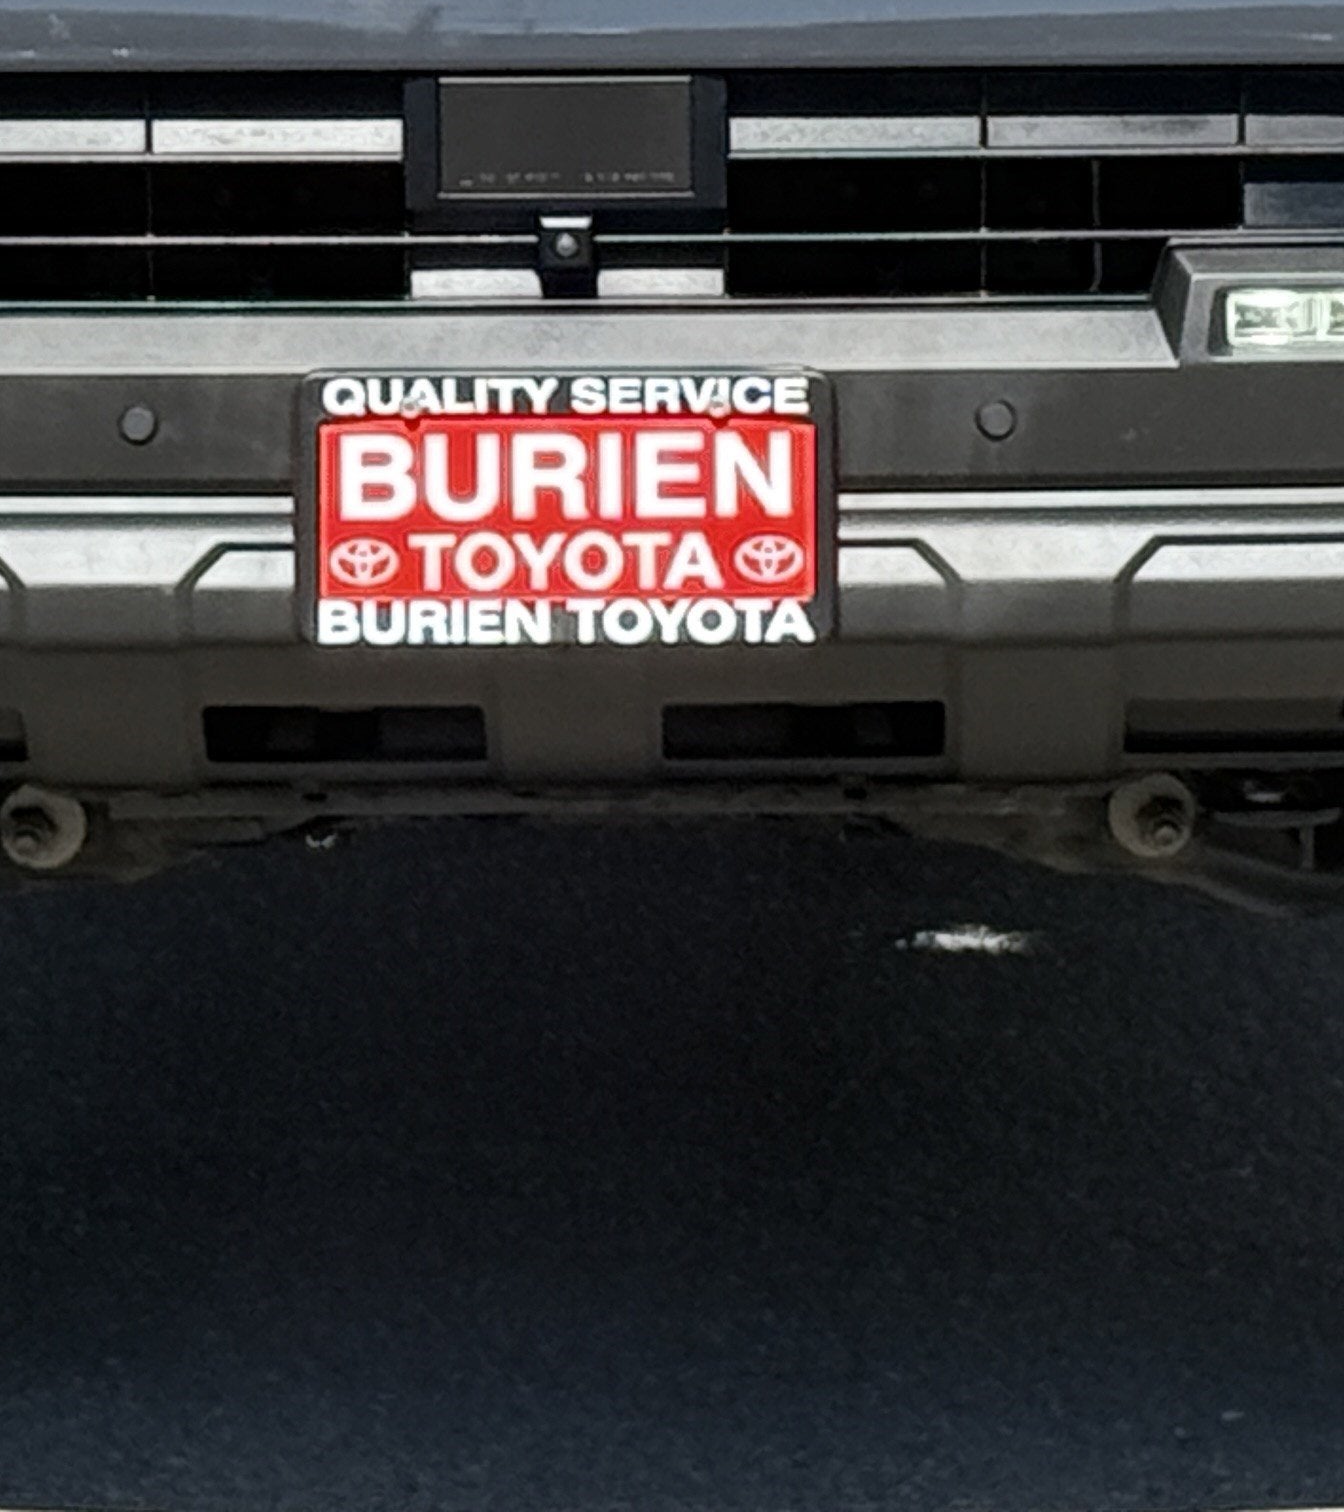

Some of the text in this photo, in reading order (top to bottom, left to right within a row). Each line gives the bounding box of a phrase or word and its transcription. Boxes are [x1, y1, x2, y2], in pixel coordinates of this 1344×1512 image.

[322, 376, 810, 416] QUALITY SERVICE
[338, 430, 794, 521] BURIEN
[408, 530, 726, 591] TOYOTA
[317, 599, 817, 645] BURIEN TOYOTA
